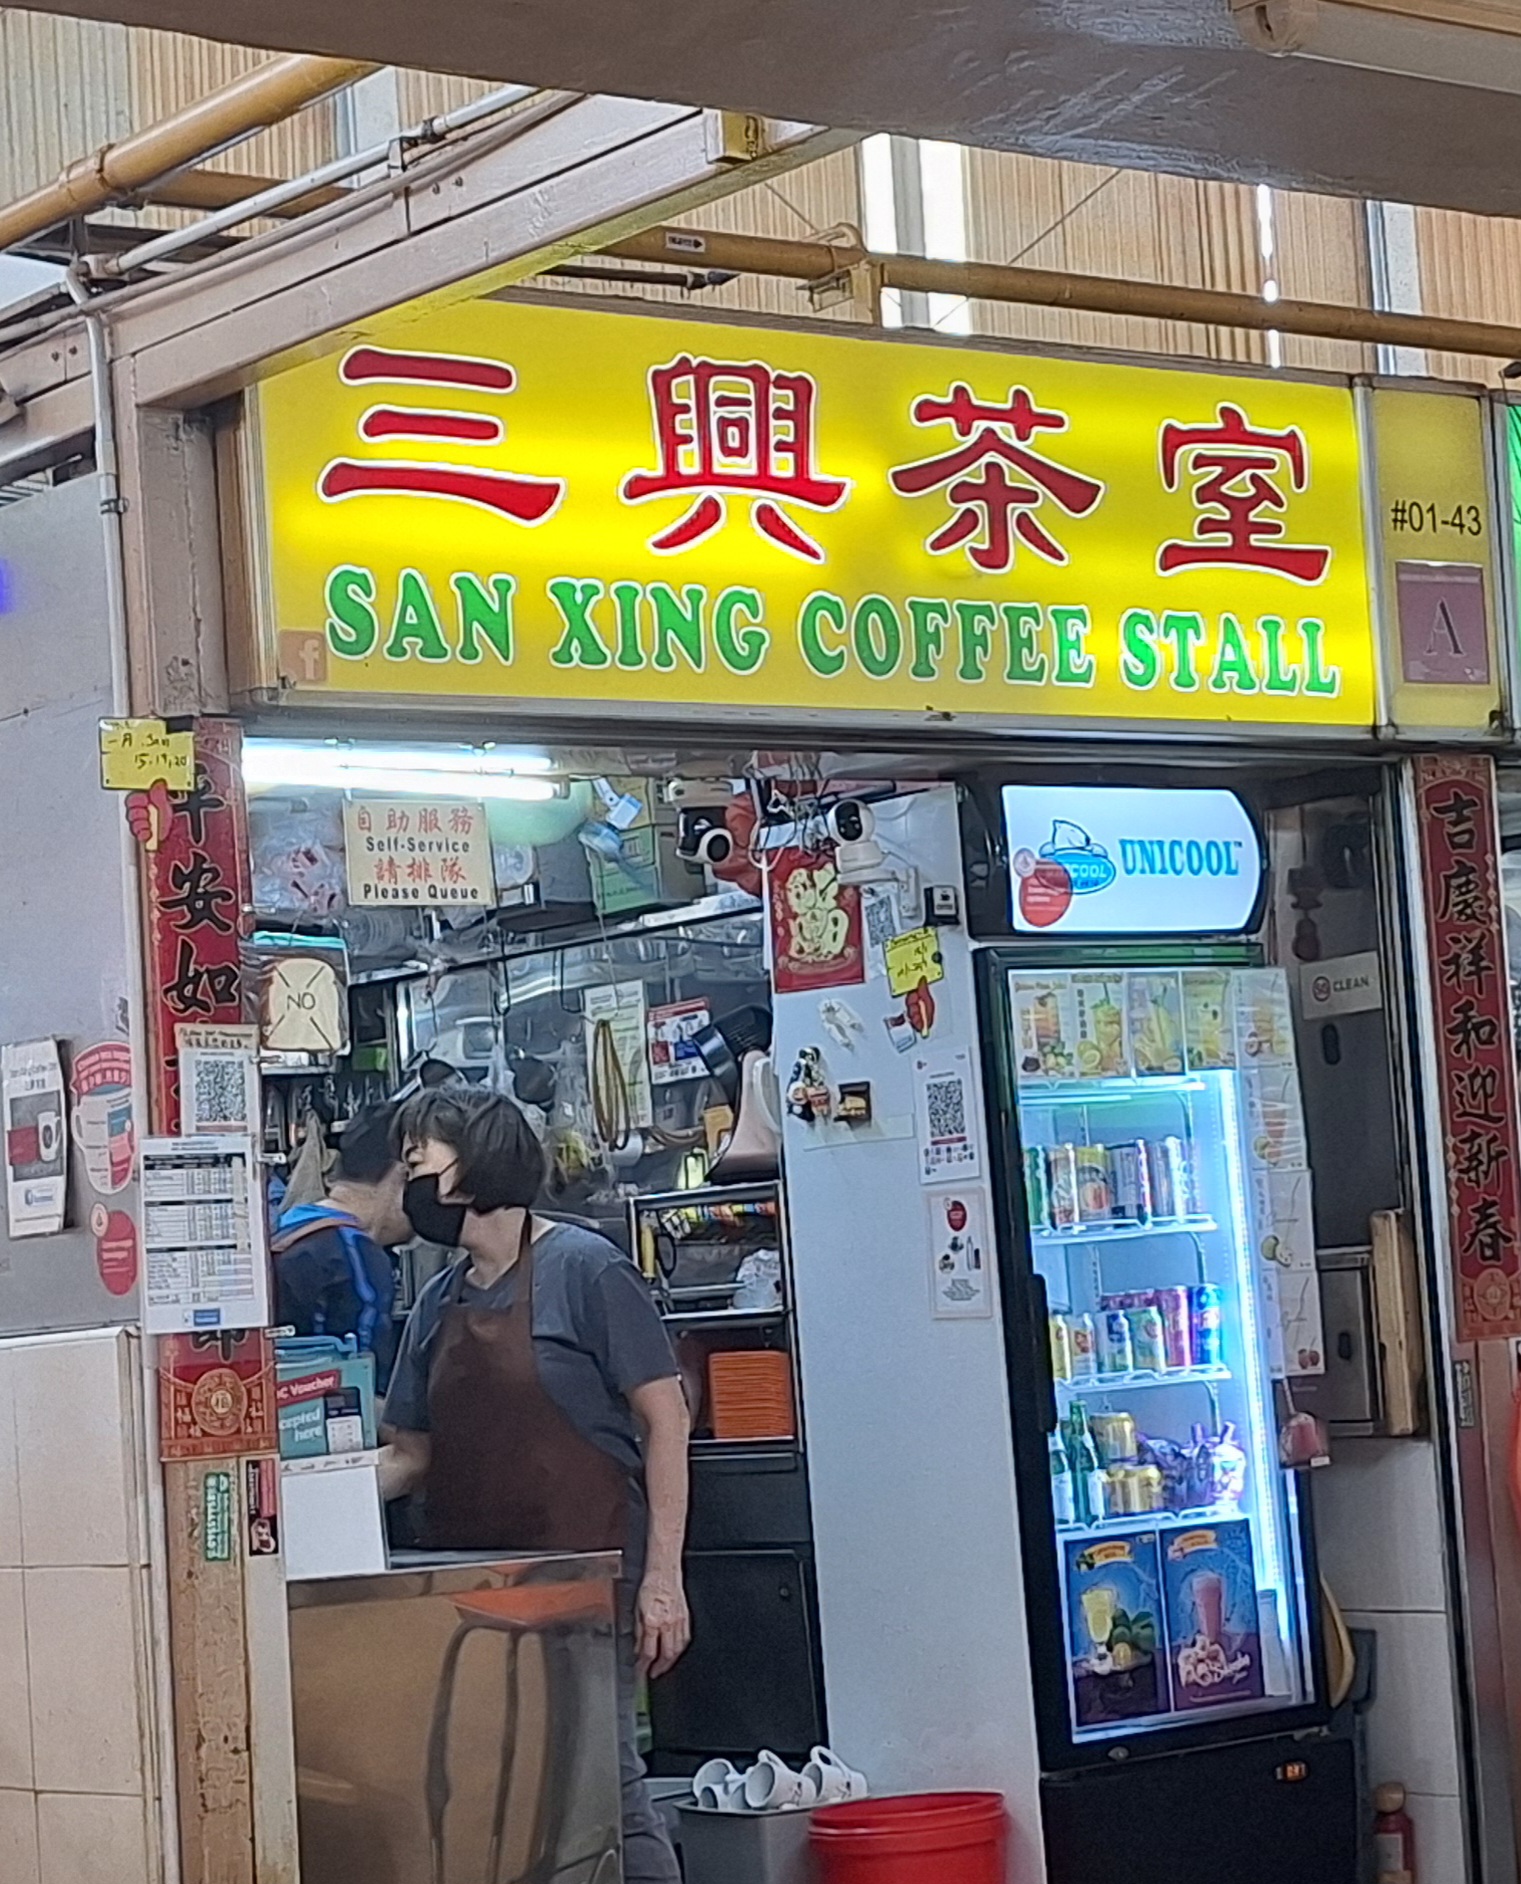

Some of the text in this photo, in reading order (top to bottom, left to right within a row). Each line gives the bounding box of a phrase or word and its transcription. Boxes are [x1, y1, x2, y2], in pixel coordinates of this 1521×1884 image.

[318, 347, 1331, 586] 三興茶室
[1391, 499, 1482, 536] #01-43
[326, 565, 1340, 698] SAN XING COFFEE STALL
[1424, 597, 1466, 656] A
[358, 806, 474, 835] 自助服務
[366, 836, 470, 852] Self-Service
[374, 856, 467, 885] 請排隊
[363, 883, 479, 899] Please Queue
[1332, 975, 1370, 992] CLEAN
[287, 992, 316, 1010] NO
[290, 1376, 334, 1396] Voucher
